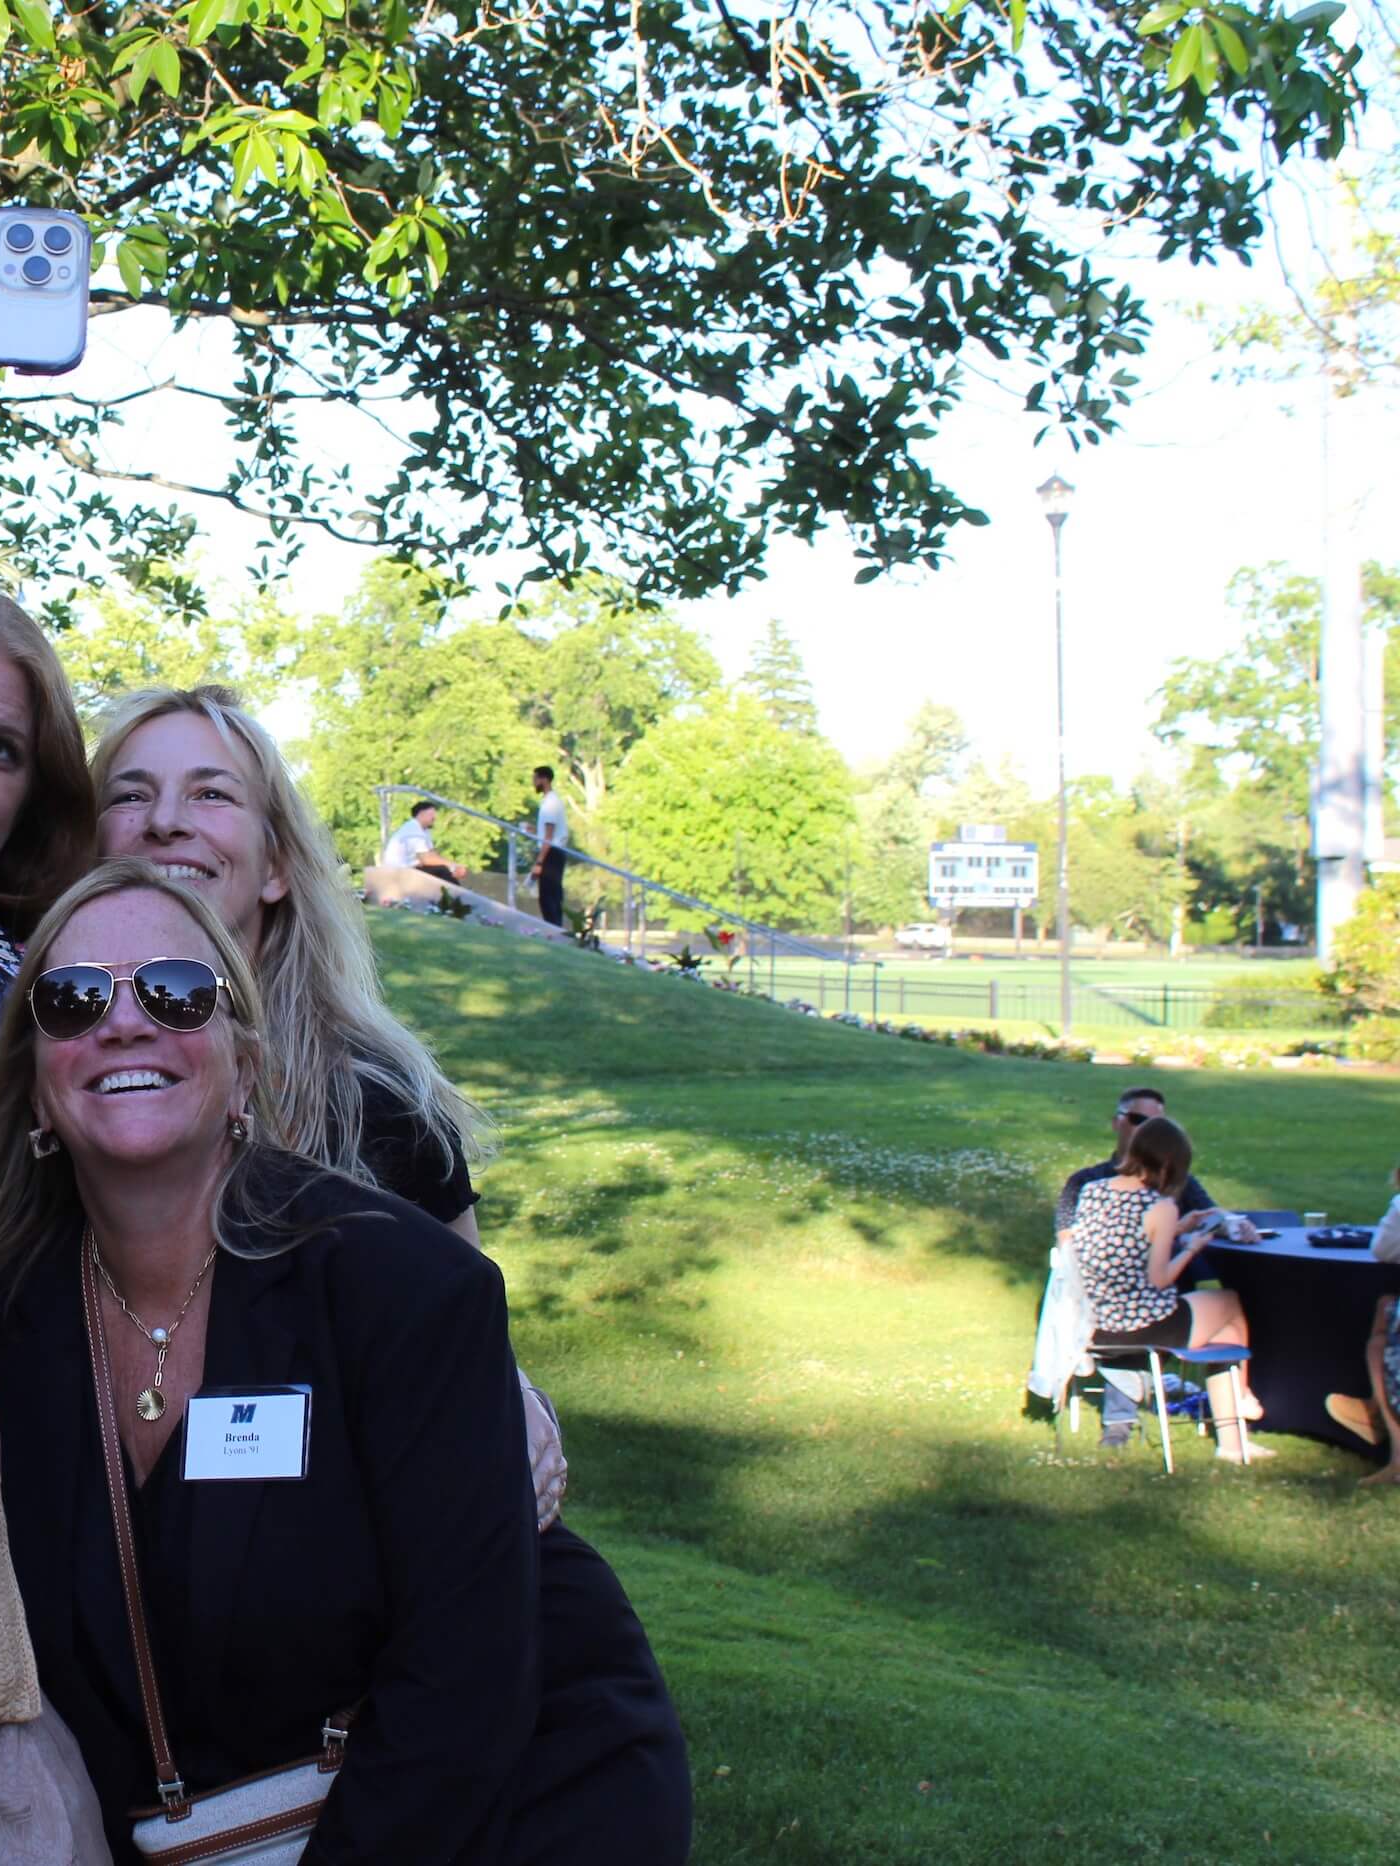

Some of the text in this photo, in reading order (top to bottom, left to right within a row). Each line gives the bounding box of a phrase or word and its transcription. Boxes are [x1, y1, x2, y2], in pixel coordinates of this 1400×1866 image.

[230, 1403, 257, 1424] M
[225, 1432, 260, 1442] Brenda
[223, 1446, 247, 1457] Lyons
